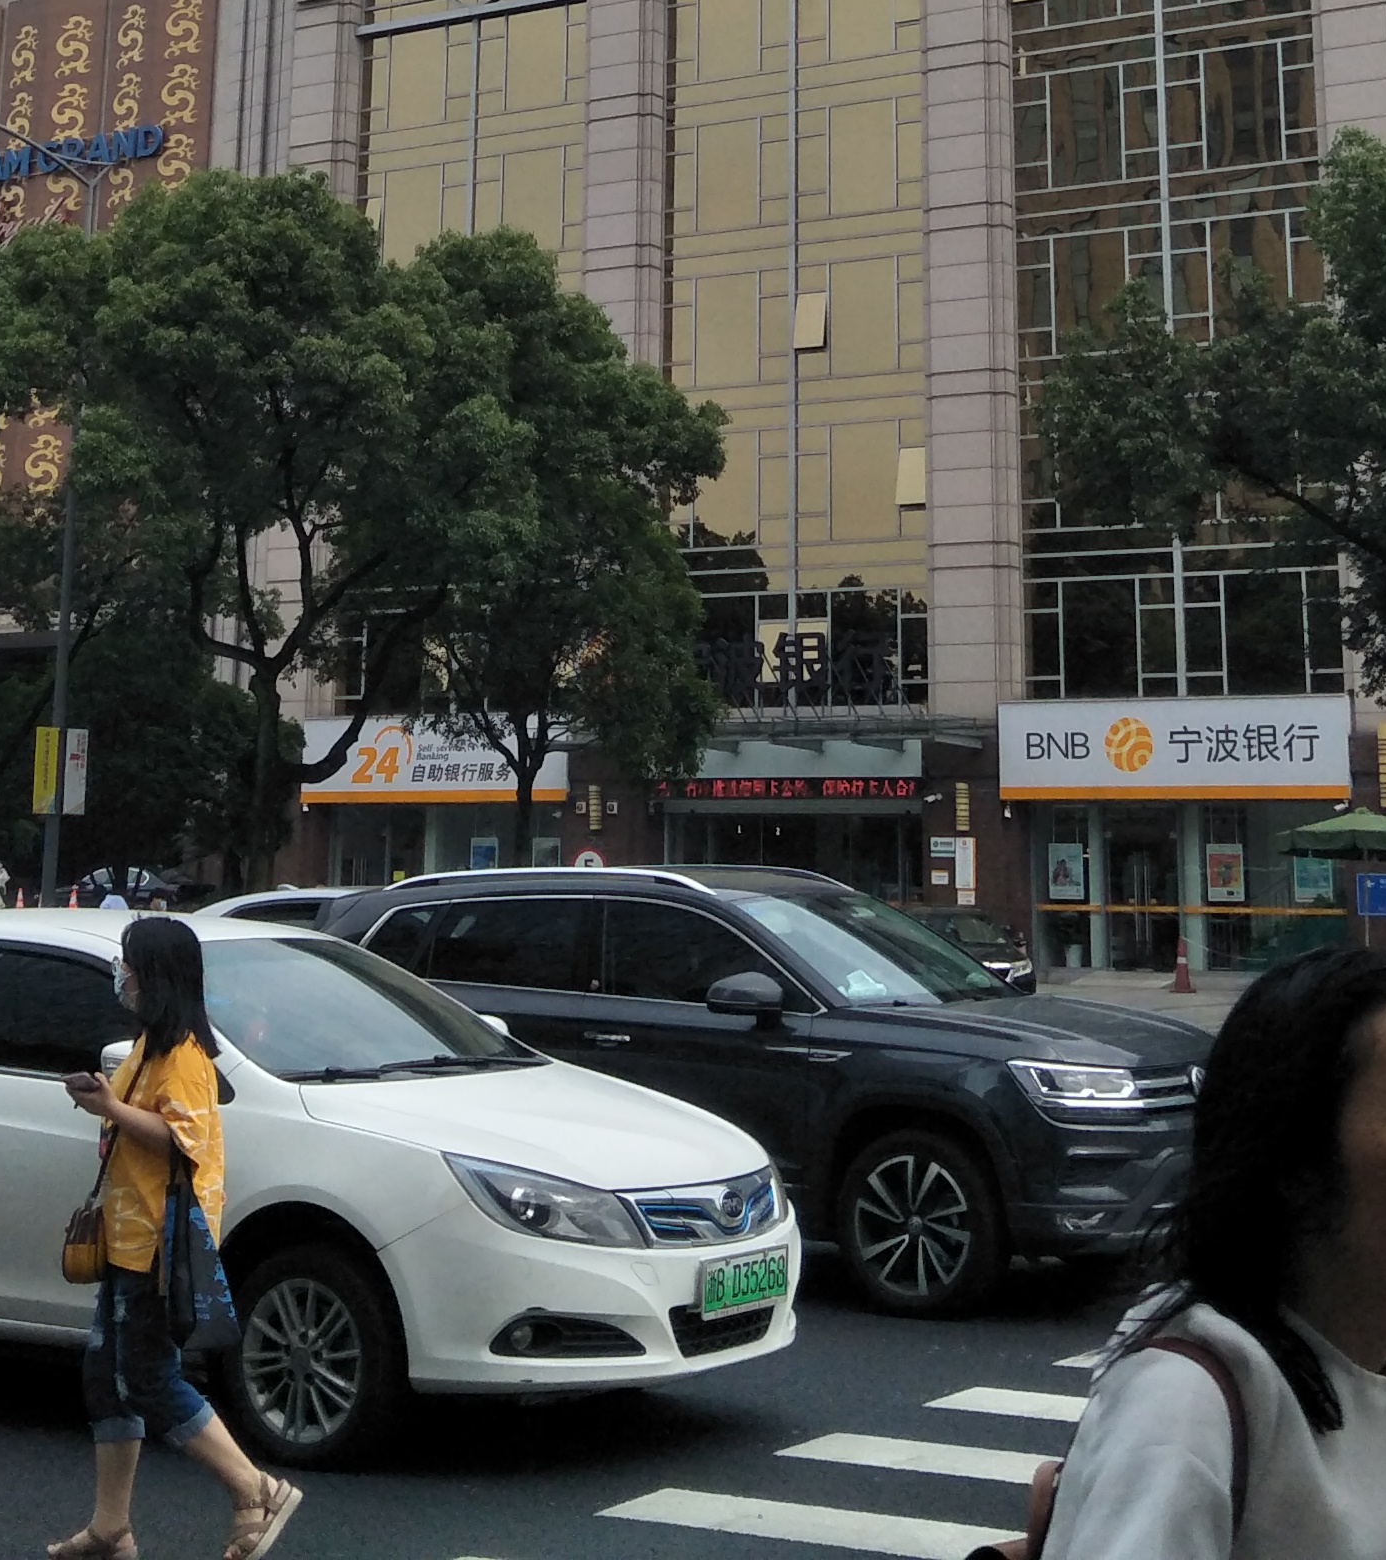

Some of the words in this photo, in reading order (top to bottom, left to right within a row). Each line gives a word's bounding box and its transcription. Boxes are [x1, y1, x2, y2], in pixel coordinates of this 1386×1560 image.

[38, 124, 163, 172] GRAND
[416, 752, 449, 761] Banking
[1025, 732, 1090, 760] BNB
[1168, 723, 1320, 763] 宁波银行
[351, 747, 399, 783] 24
[411, 763, 512, 783] 自助银行服务
[732, 1255, 785, 1298] D35268
